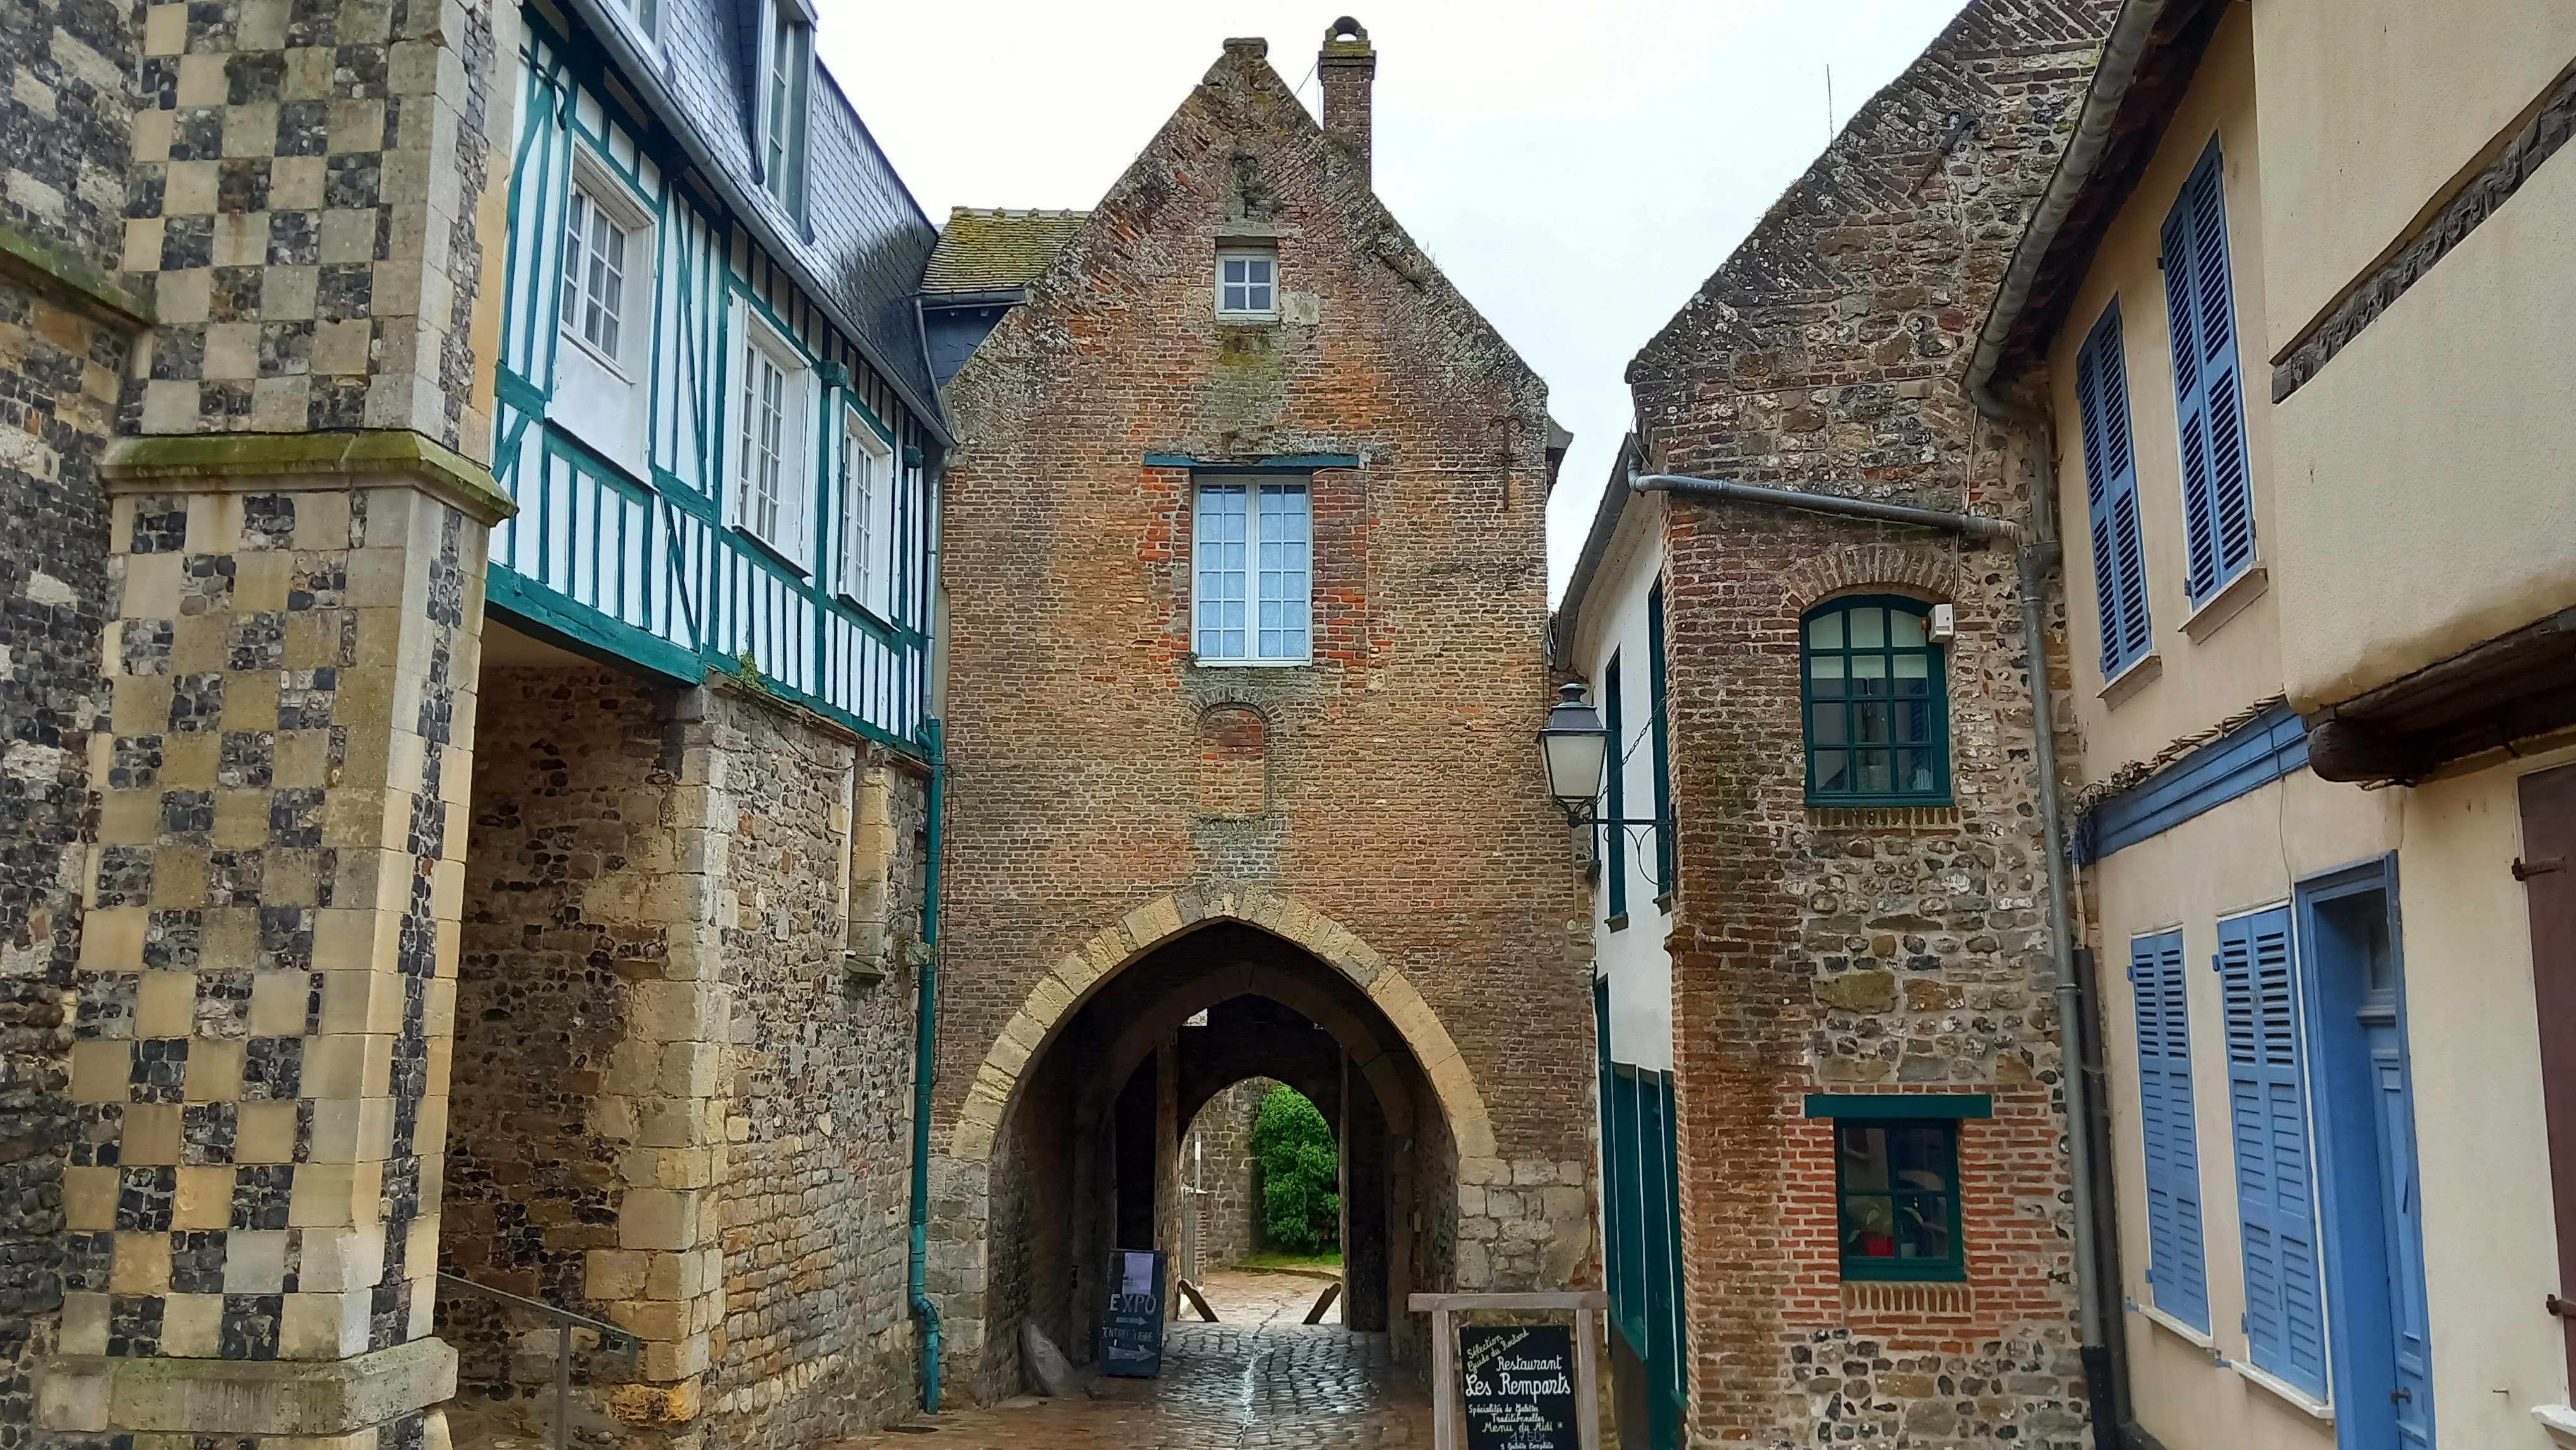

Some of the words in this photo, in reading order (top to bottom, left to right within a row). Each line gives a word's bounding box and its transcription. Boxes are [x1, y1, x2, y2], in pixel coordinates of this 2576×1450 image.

[1109, 1293, 1157, 1315] EXPO
[1467, 1334, 1503, 1359] Sélection
[1467, 1353, 1490, 1374] Guide
[1491, 1346, 1501, 1357] du
[1500, 1326, 1530, 1351] Routard
[1496, 1353, 1563, 1372] Restaurant
[1465, 1373, 1492, 1398] Les
[1498, 1372, 1571, 1404] Remparts
[1468, 1403, 1503, 1418] Spécialités
[1505, 1403, 1513, 1413] de
[1482, 1422, 1513, 1433] Menu
[1518, 1421, 1530, 1432] du
[1533, 1421, 1553, 1432] Midi
